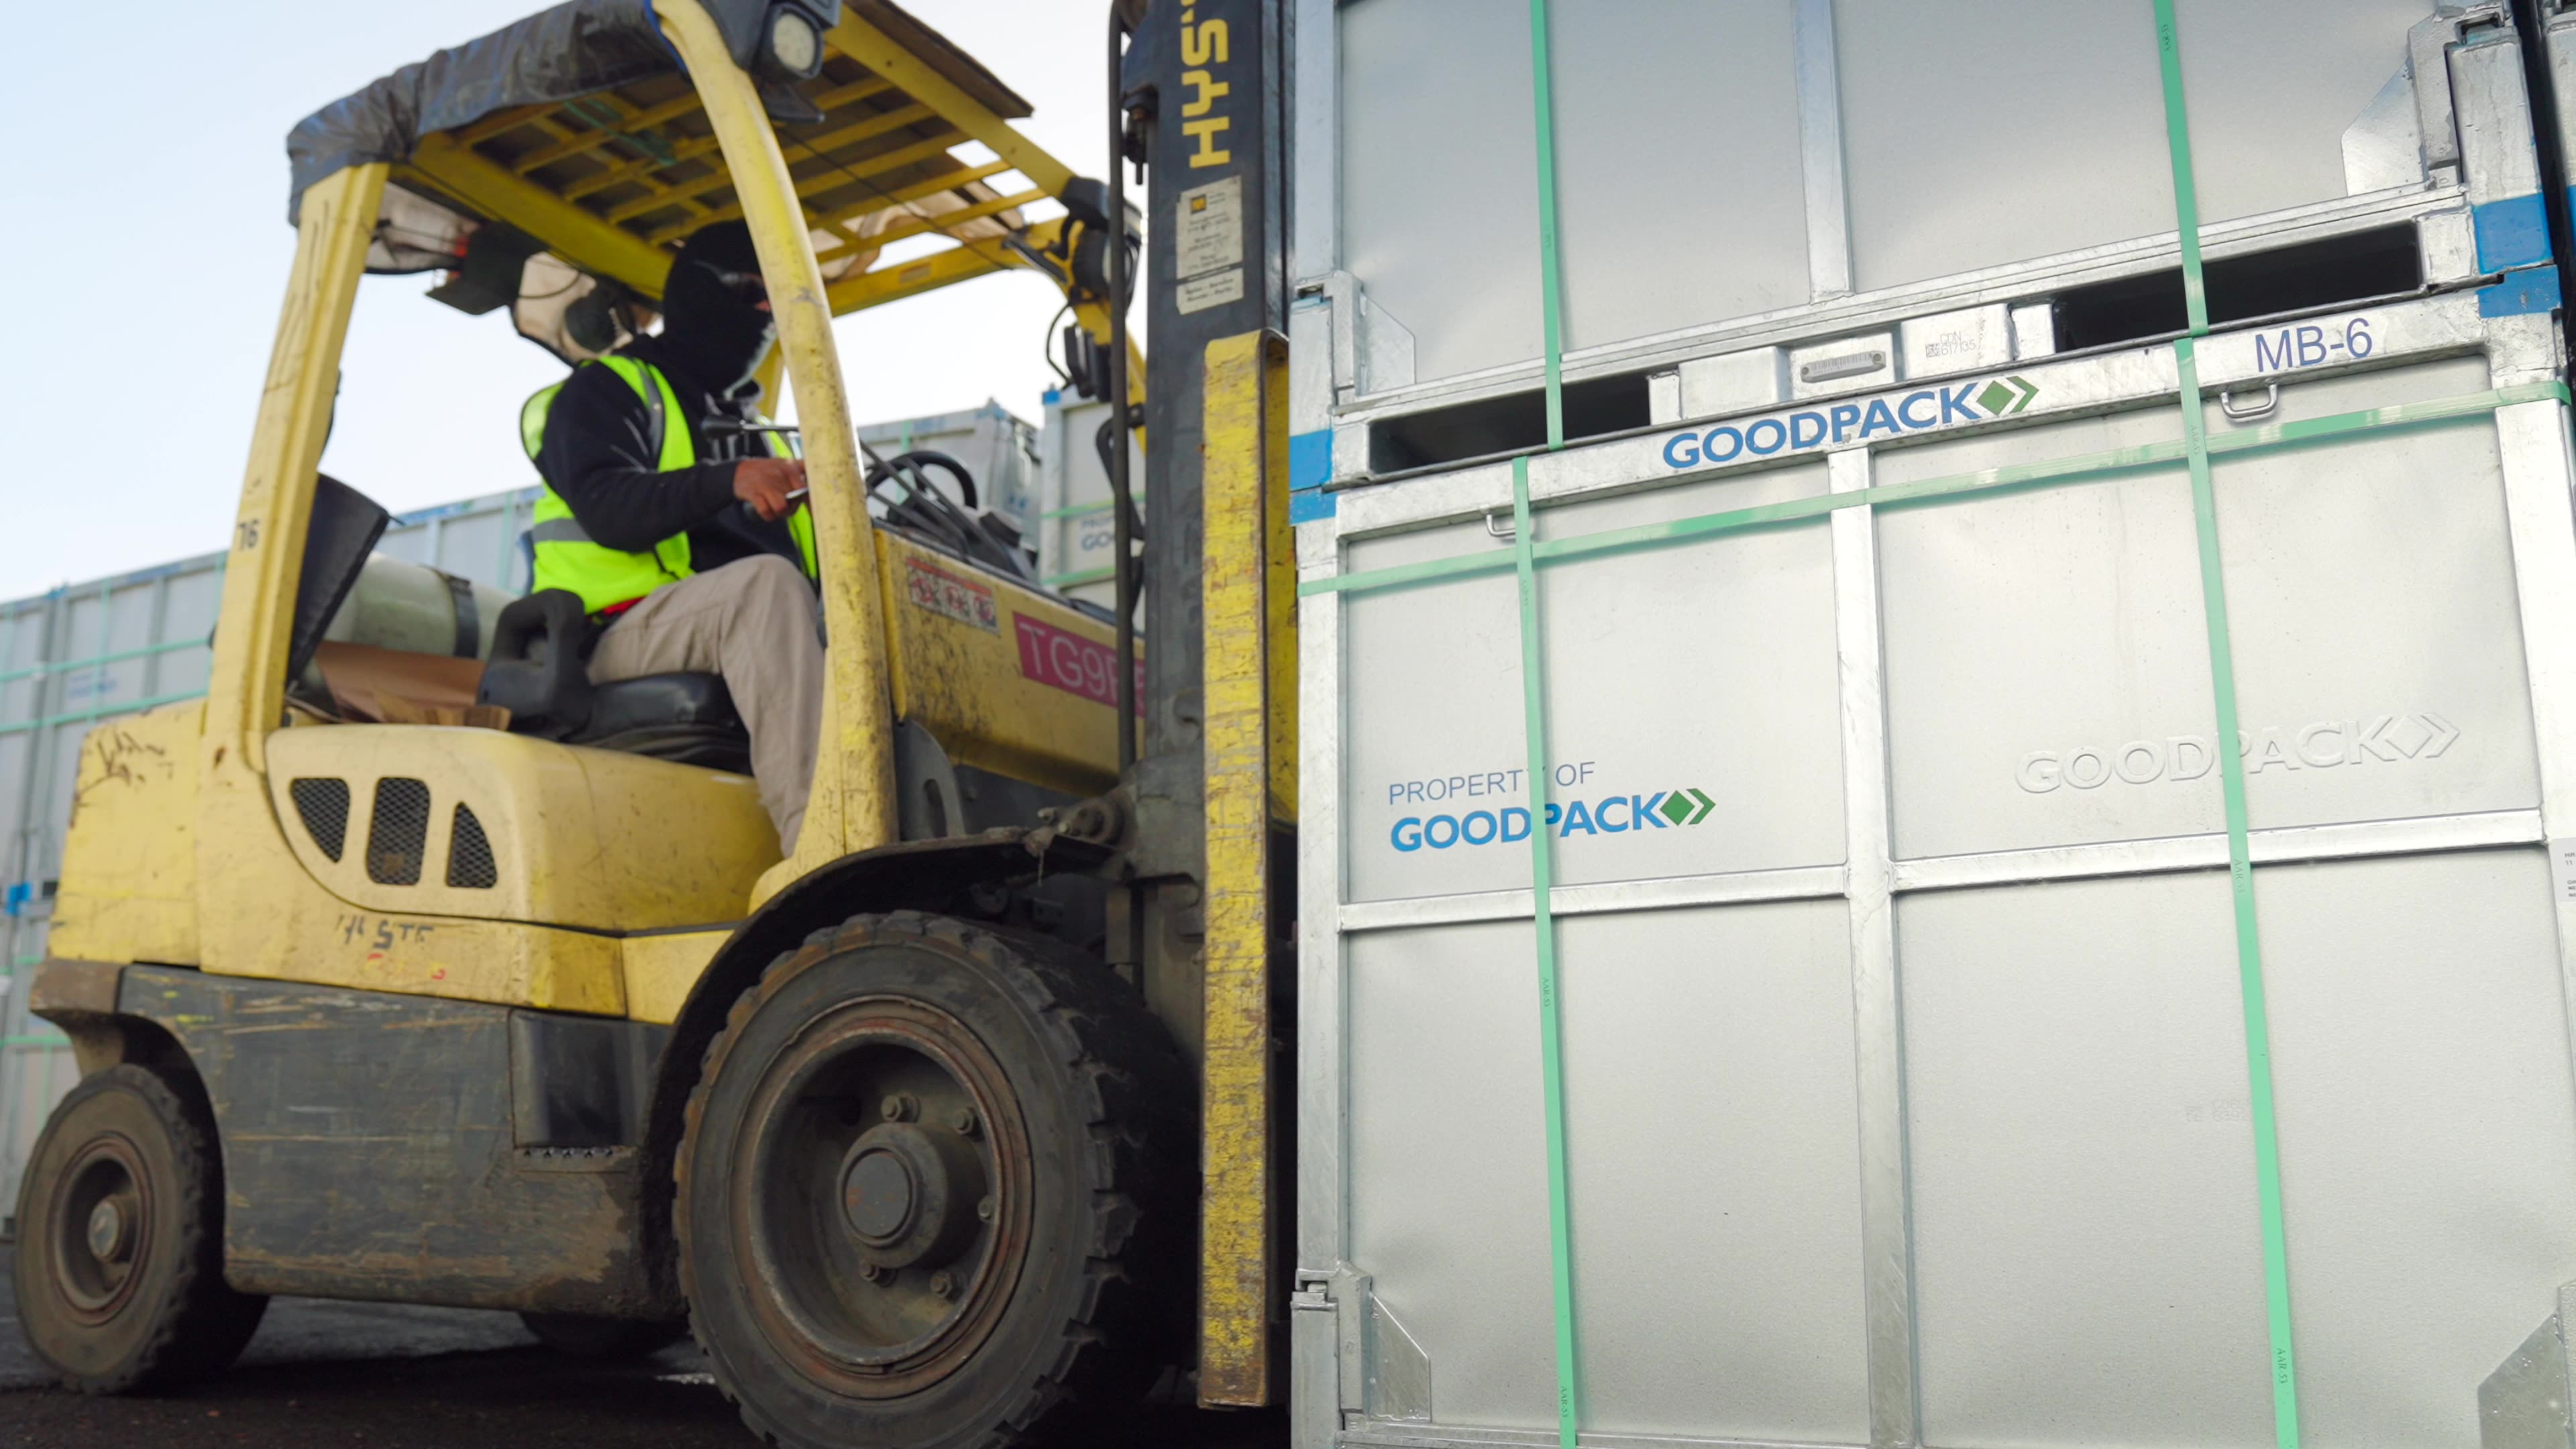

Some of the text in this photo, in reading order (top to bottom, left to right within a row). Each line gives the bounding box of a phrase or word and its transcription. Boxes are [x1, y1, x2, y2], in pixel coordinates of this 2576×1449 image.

[2255, 317, 2373, 373] MB-6
[1663, 382, 1981, 469] GOODPACK
[1389, 761, 1595, 805] PROPERT OF
